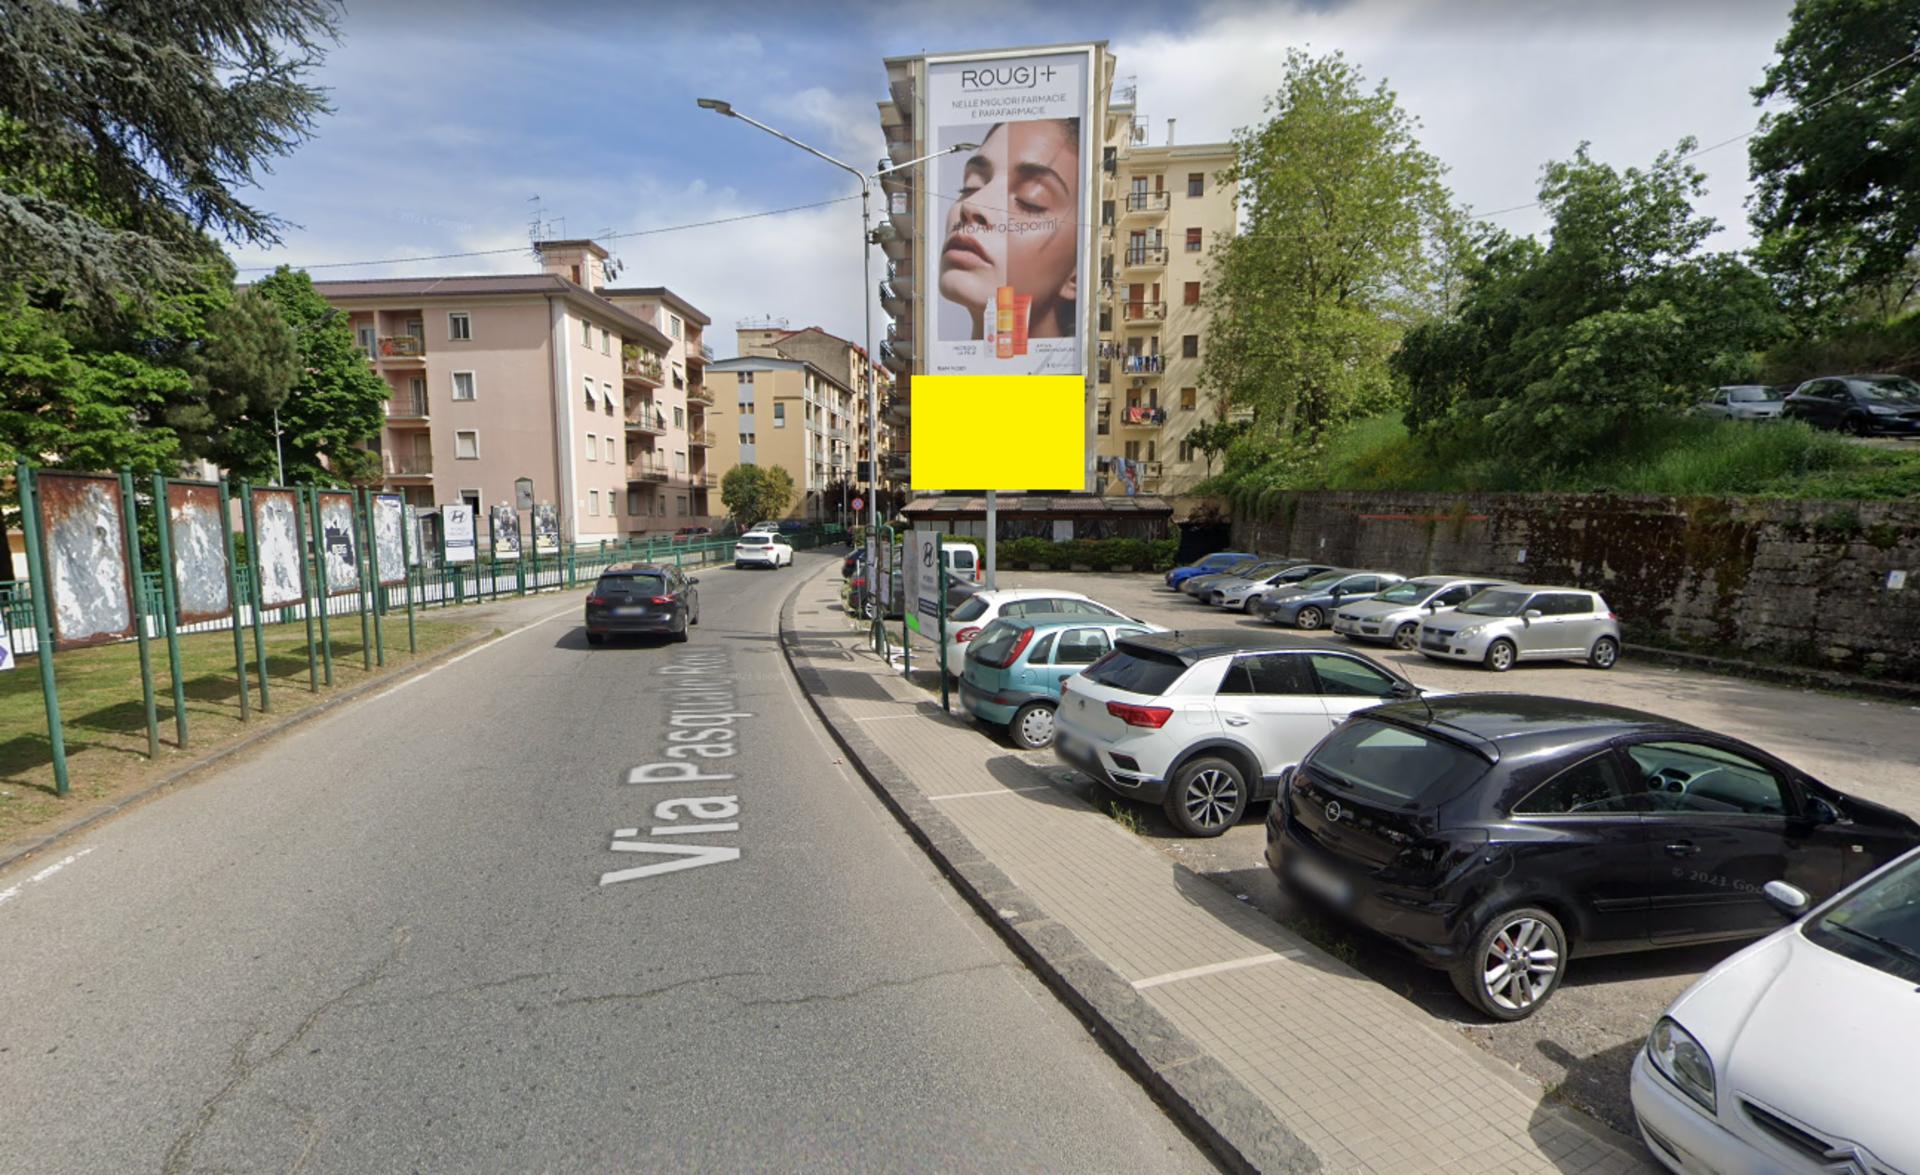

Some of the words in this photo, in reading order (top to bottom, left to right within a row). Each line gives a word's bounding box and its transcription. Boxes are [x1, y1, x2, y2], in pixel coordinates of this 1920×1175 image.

[952, 98, 979, 109] NELLE
[980, 96, 1020, 108] MIGLIORI
[1021, 93, 1067, 104] FARMACIE
[971, 110, 978, 118] E
[979, 106, 1046, 118] PARAFARMACIE
